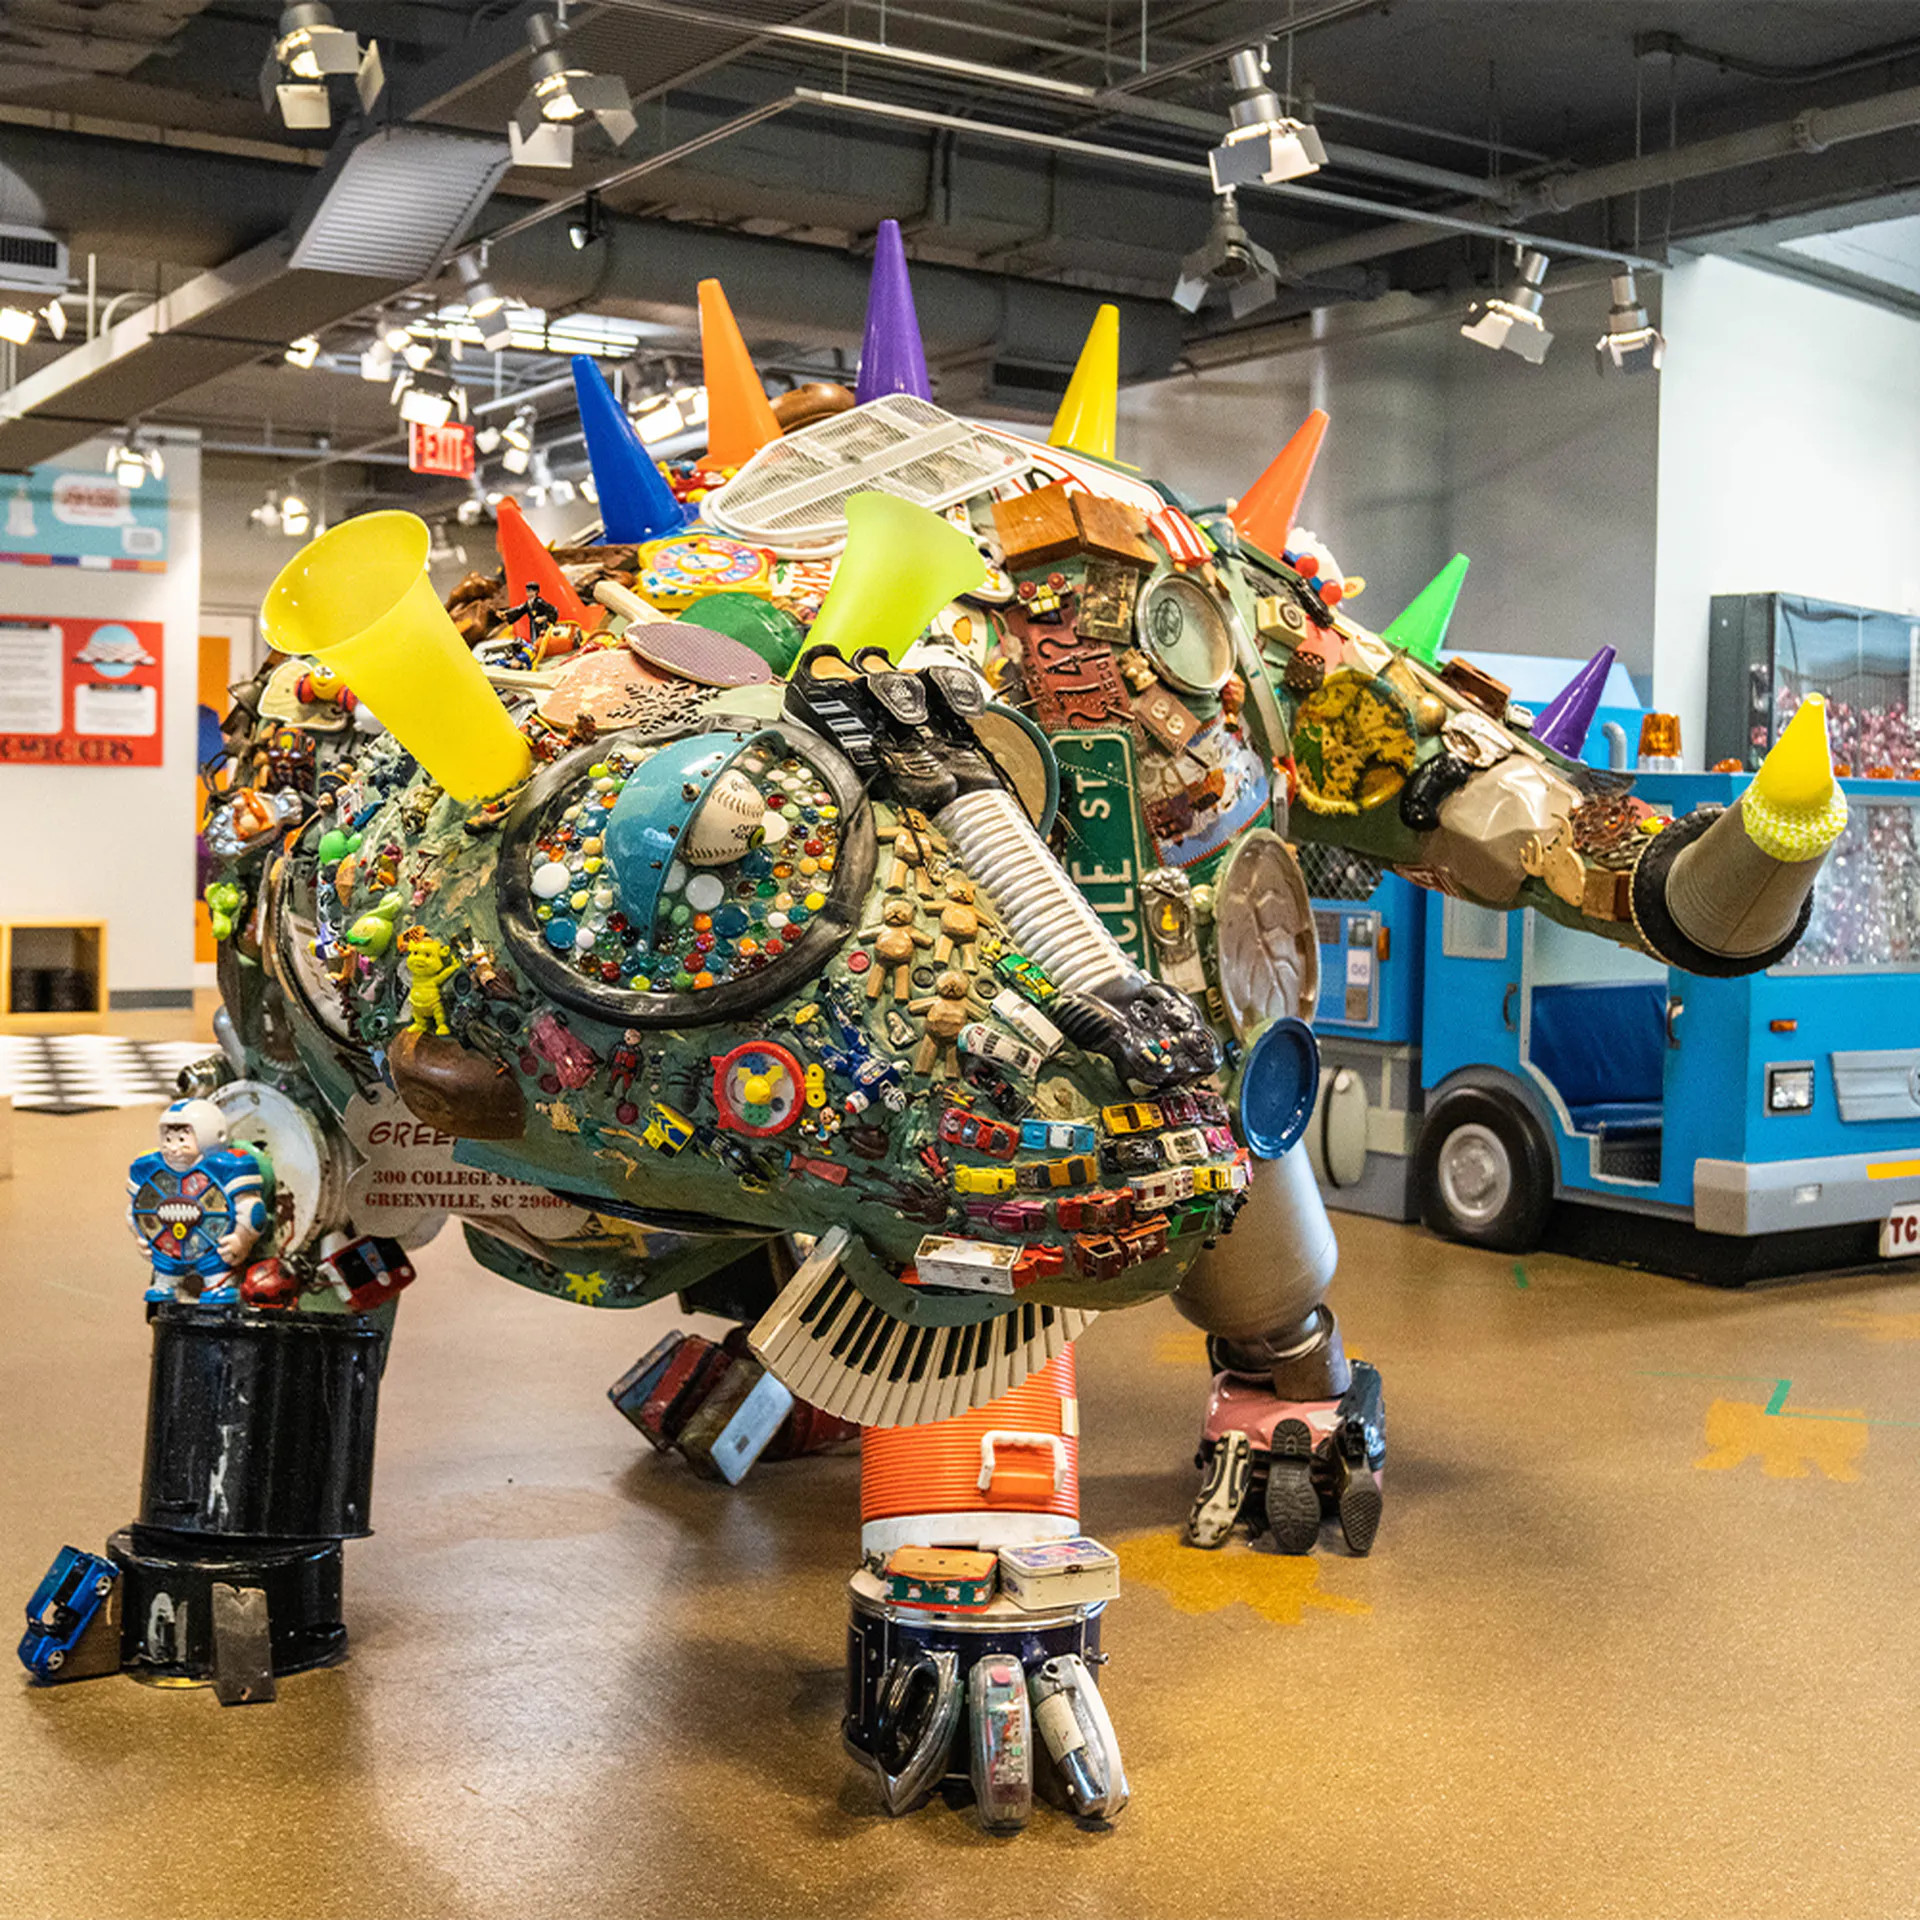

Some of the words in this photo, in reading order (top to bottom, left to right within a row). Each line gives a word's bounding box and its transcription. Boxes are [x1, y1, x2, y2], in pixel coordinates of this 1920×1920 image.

[423, 426, 465, 472] EXIT
[1076, 773, 1111, 819] ST
[1072, 859, 1138, 961] CLE
[368, 1121, 458, 1148] GREE
[372, 1170, 407, 1186] 300
[411, 1170, 492, 1186] COLLEGE
[365, 1192, 485, 1209] GREENVILLE,
[490, 1194, 514, 1208] SC
[1890, 1216, 1919, 1245] TC
